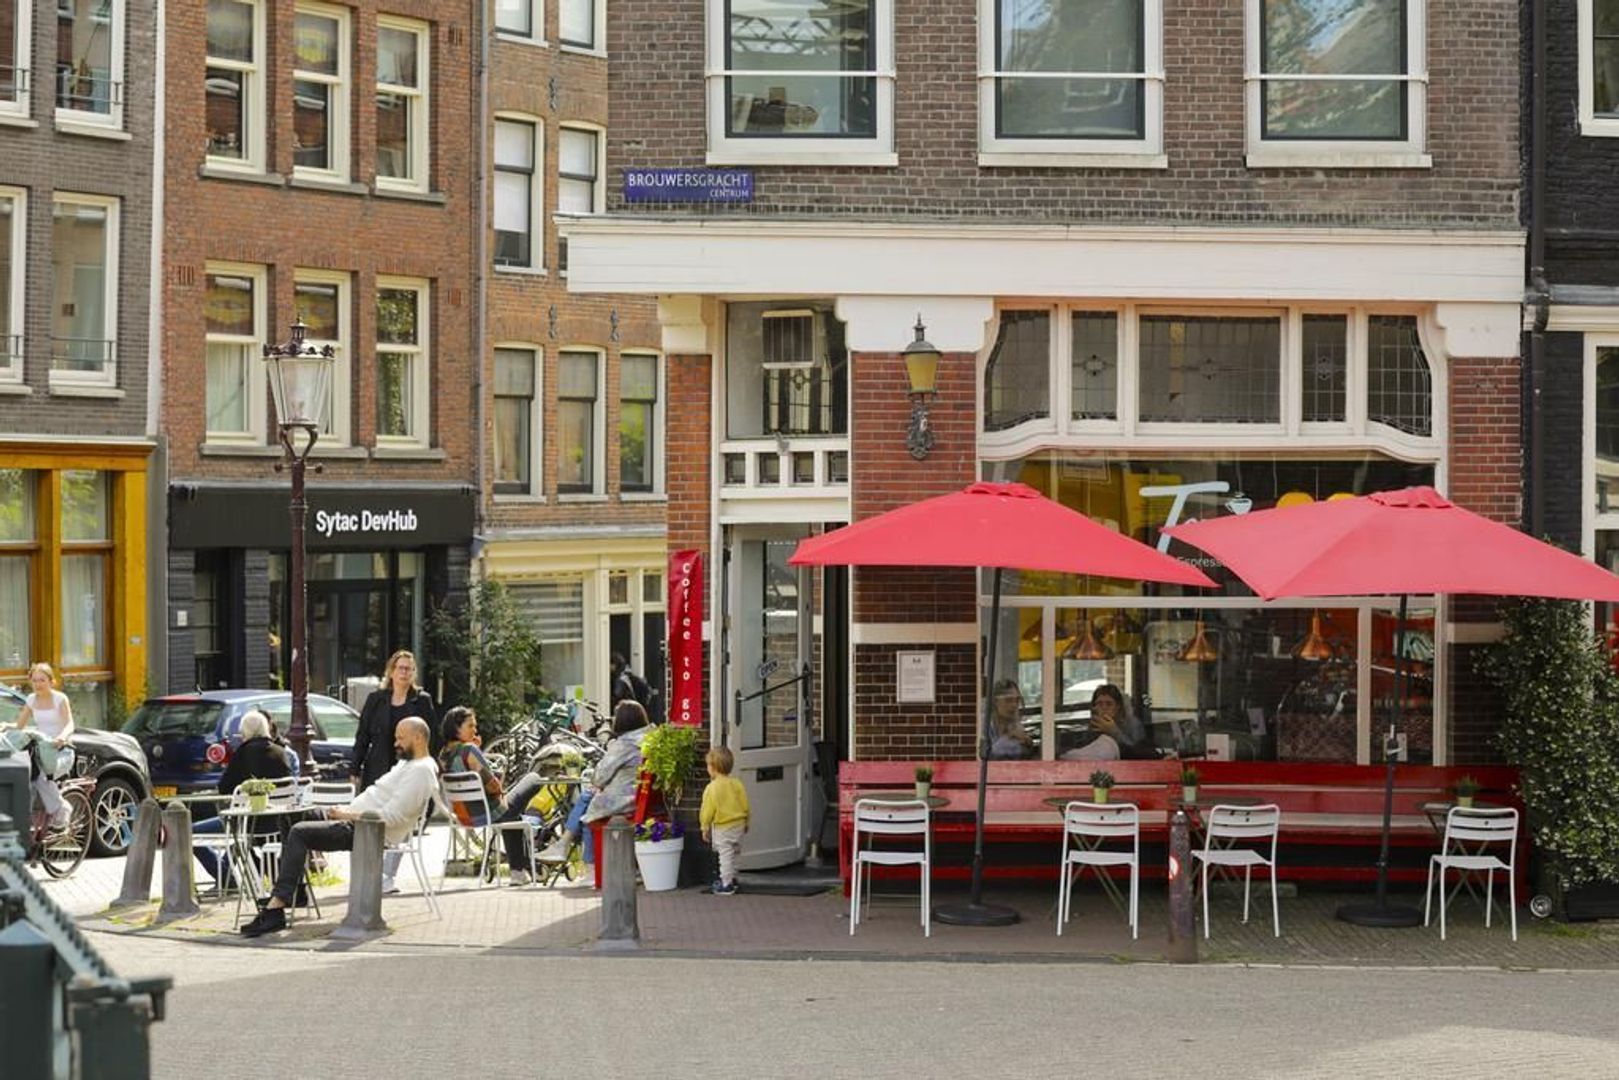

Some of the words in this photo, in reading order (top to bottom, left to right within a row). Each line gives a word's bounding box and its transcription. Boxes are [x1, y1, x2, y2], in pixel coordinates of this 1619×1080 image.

[628, 173, 748, 187] BROUWERSGRACHT
[709, 189, 749, 198] CENTRUM
[315, 510, 358, 537] Sytac
[361, 509, 418, 531] DevHub
[682, 656, 691, 681] to
[760, 660, 778, 677] OPEN
[681, 698, 690, 721] go
